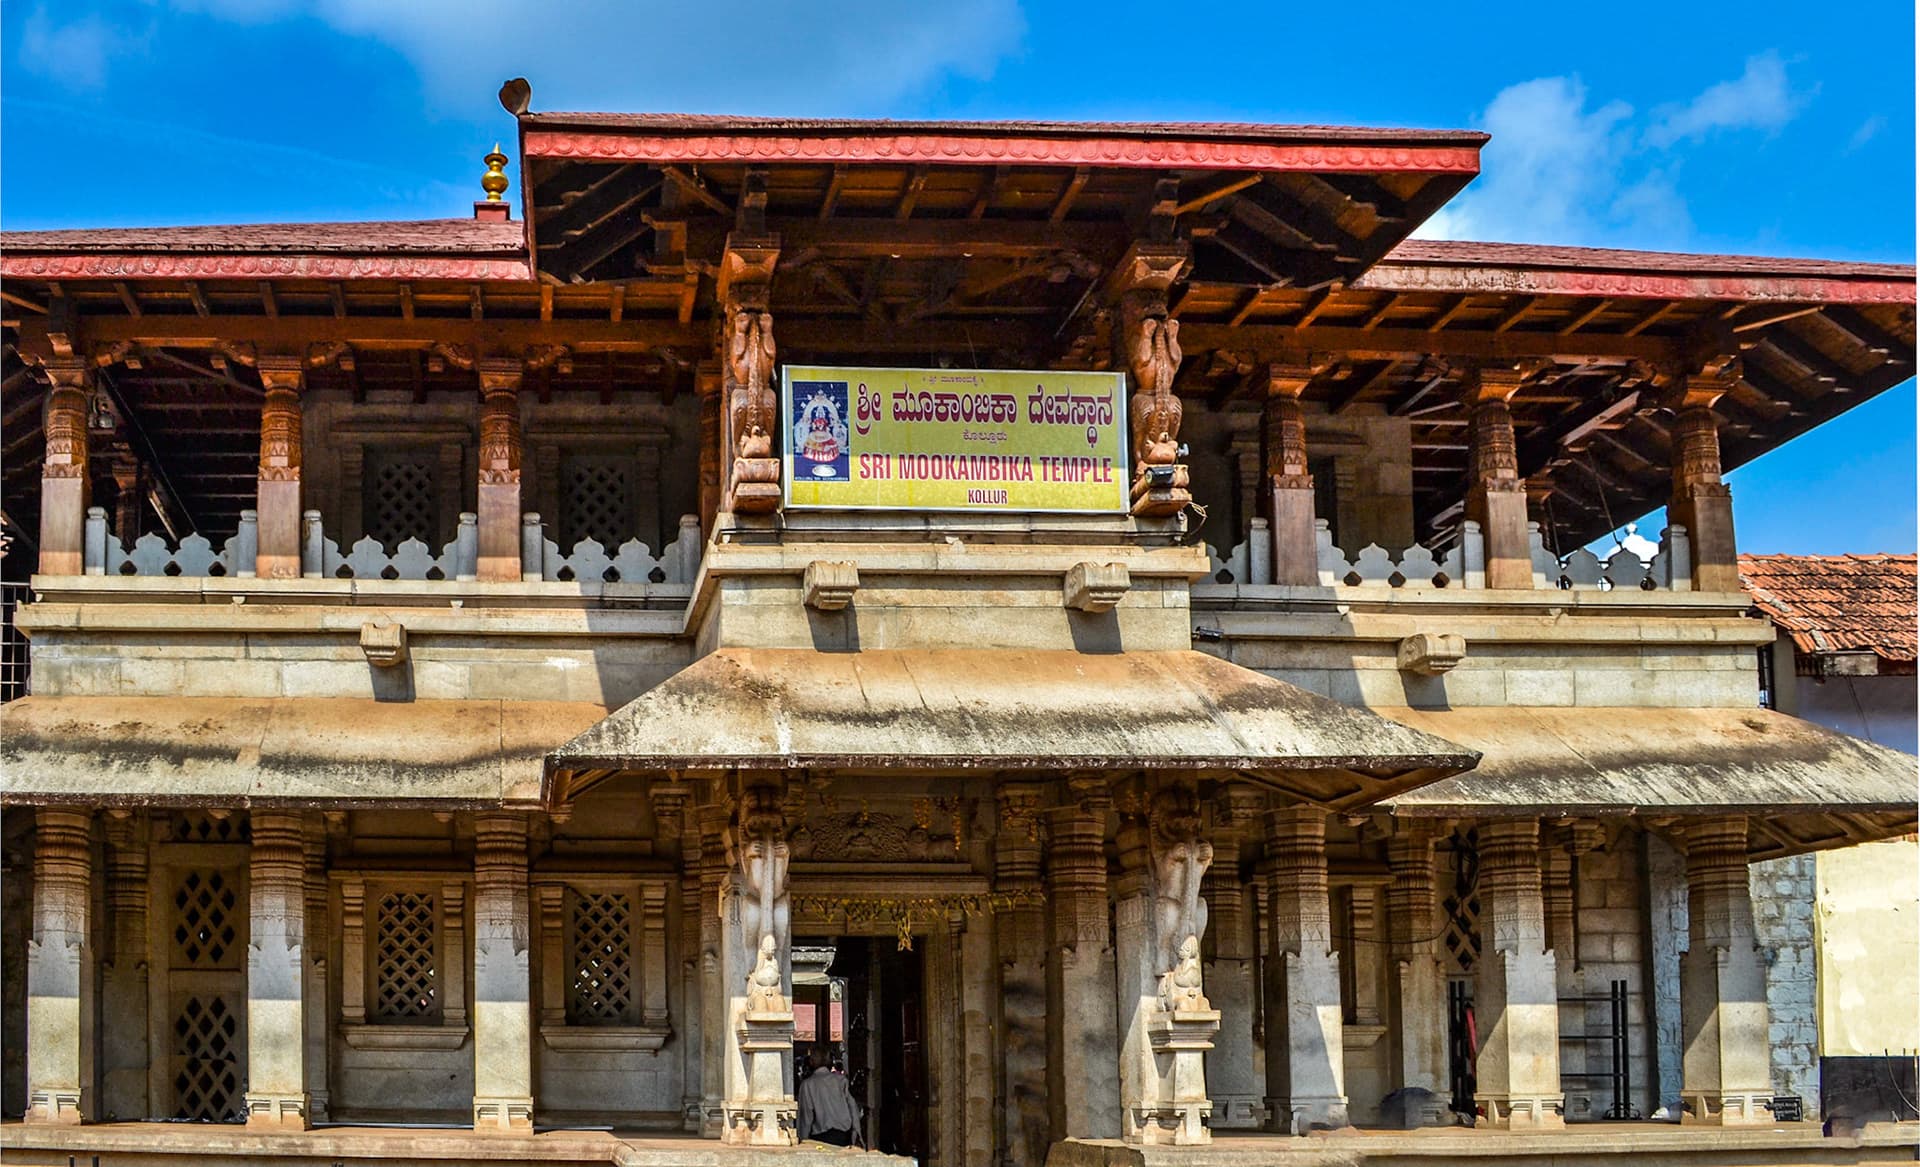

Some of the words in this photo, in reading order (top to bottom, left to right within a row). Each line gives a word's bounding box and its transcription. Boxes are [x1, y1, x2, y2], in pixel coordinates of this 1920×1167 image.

[856, 383, 881, 435] ಶ್ರೀ
[892, 384, 1017, 423] ಮೂಕಾಂಬಿಕಾ
[1028, 384, 1113, 448] ದೇವಸ್ಥಾನ
[859, 453, 891, 480] SRI
[899, 454, 1034, 482] MOOKAMBIKA
[1040, 456, 1113, 483] TEMPLE
[967, 489, 1008, 504] KOLLUR
